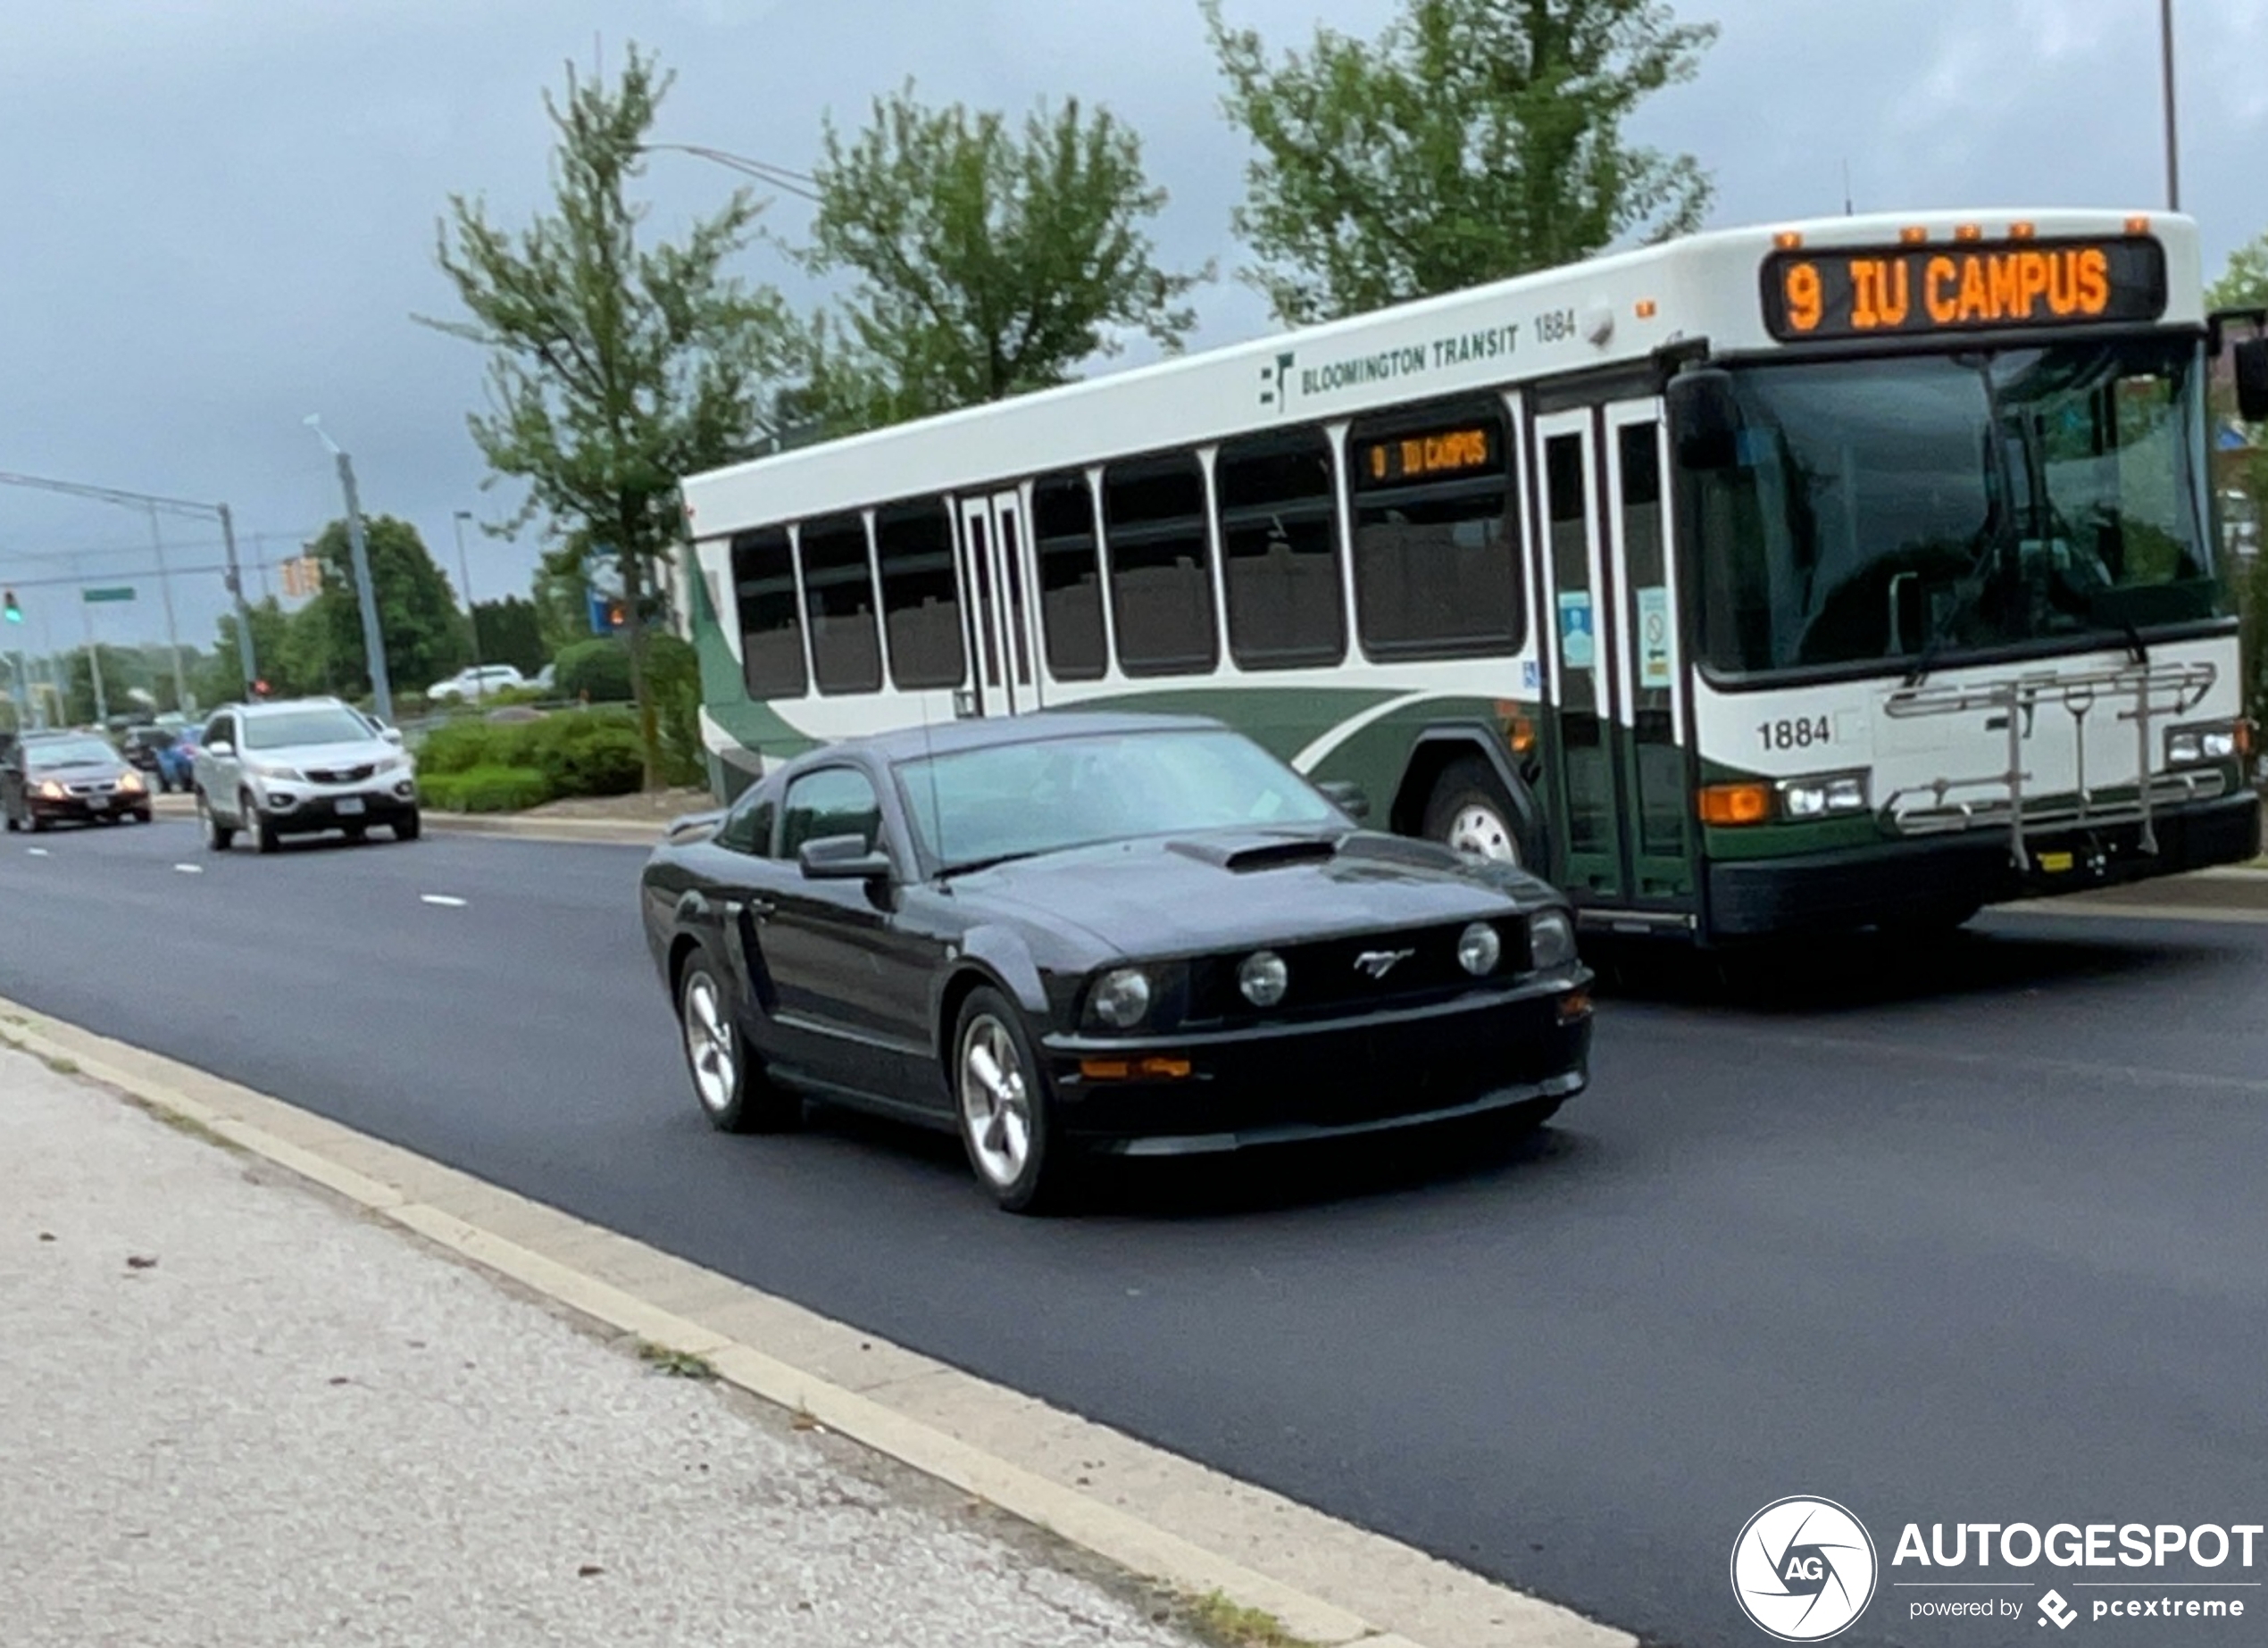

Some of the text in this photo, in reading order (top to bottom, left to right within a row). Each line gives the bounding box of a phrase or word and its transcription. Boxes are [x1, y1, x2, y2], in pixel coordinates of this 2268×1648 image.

[1786, 248, 2108, 331] 9 IU CAMPUS
[1534, 309, 1577, 344] 1884
[1302, 325, 1519, 395] BLOOMINGTON TRANSIT
[1756, 715, 1830, 751] 1884
